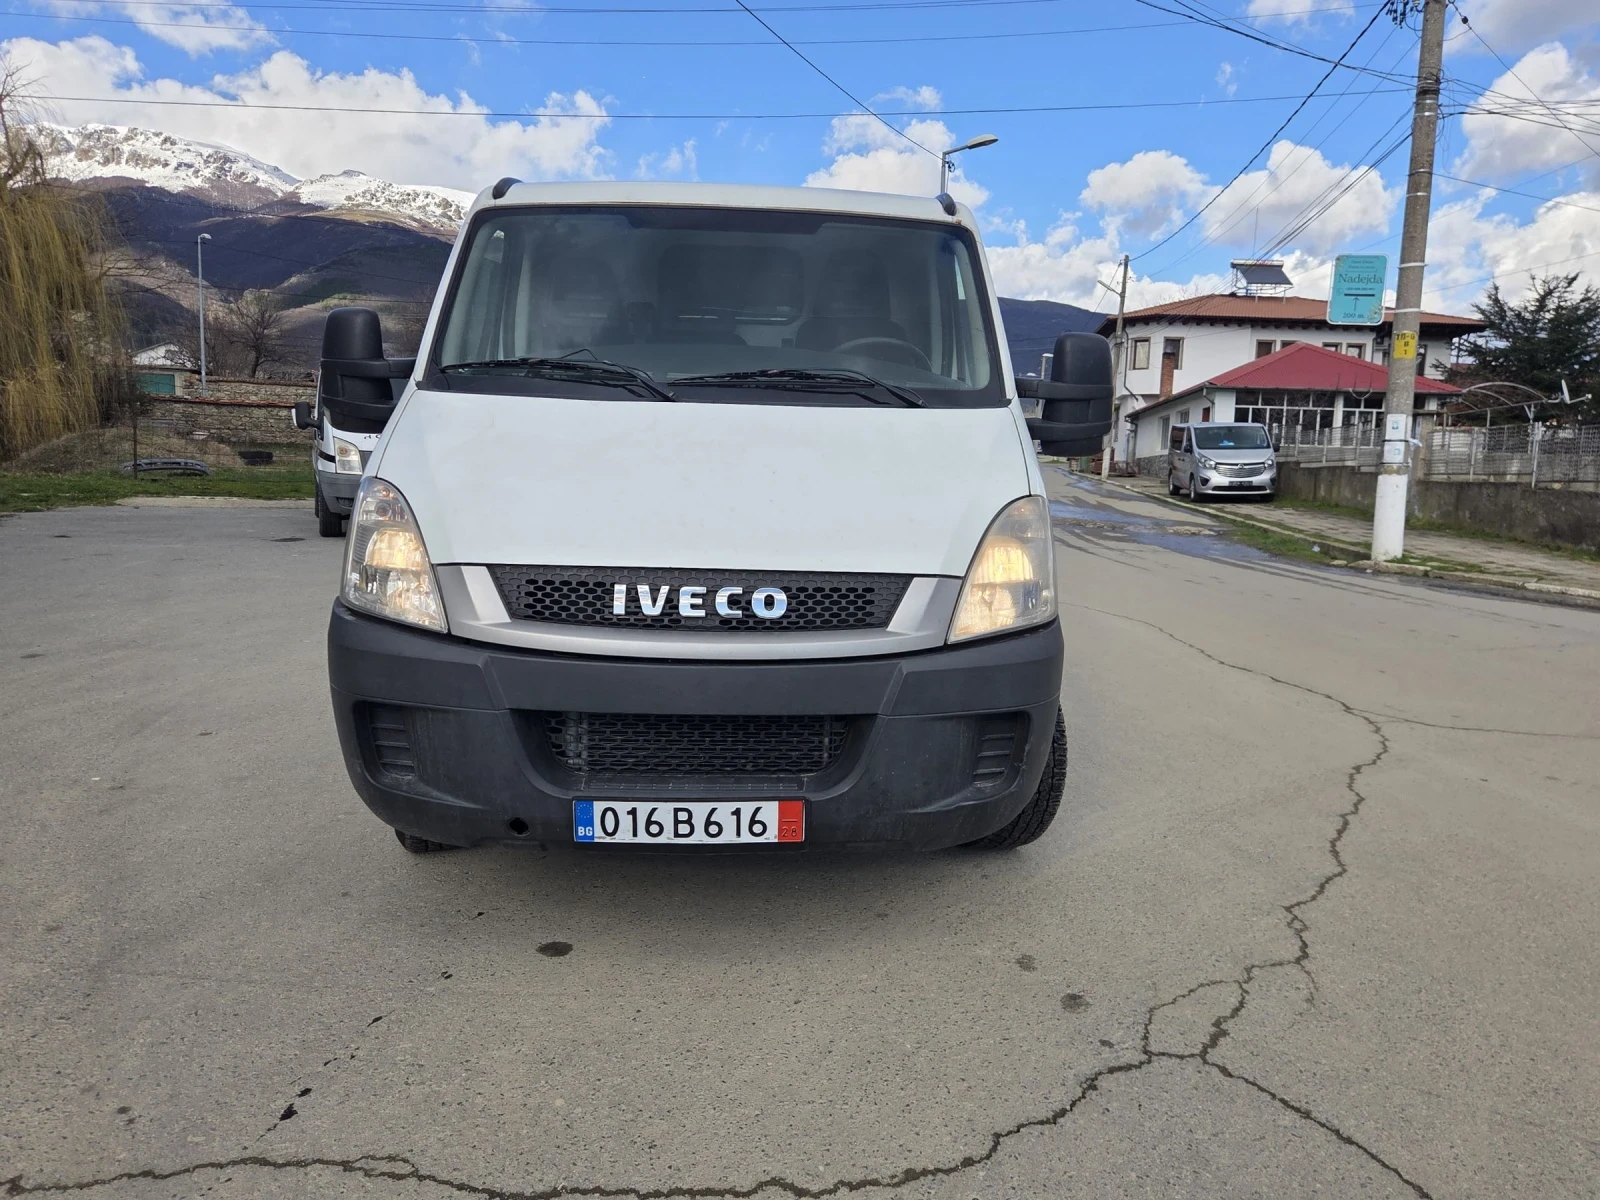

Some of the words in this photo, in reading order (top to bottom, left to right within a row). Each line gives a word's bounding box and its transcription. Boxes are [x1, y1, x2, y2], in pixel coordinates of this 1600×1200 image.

[1338, 273, 1383, 285] Nadejda
[613, 583, 788, 619] IVECO
[578, 826, 593, 836] BG
[600, 807, 768, 839] 016B616
[781, 826, 798, 837] 28
